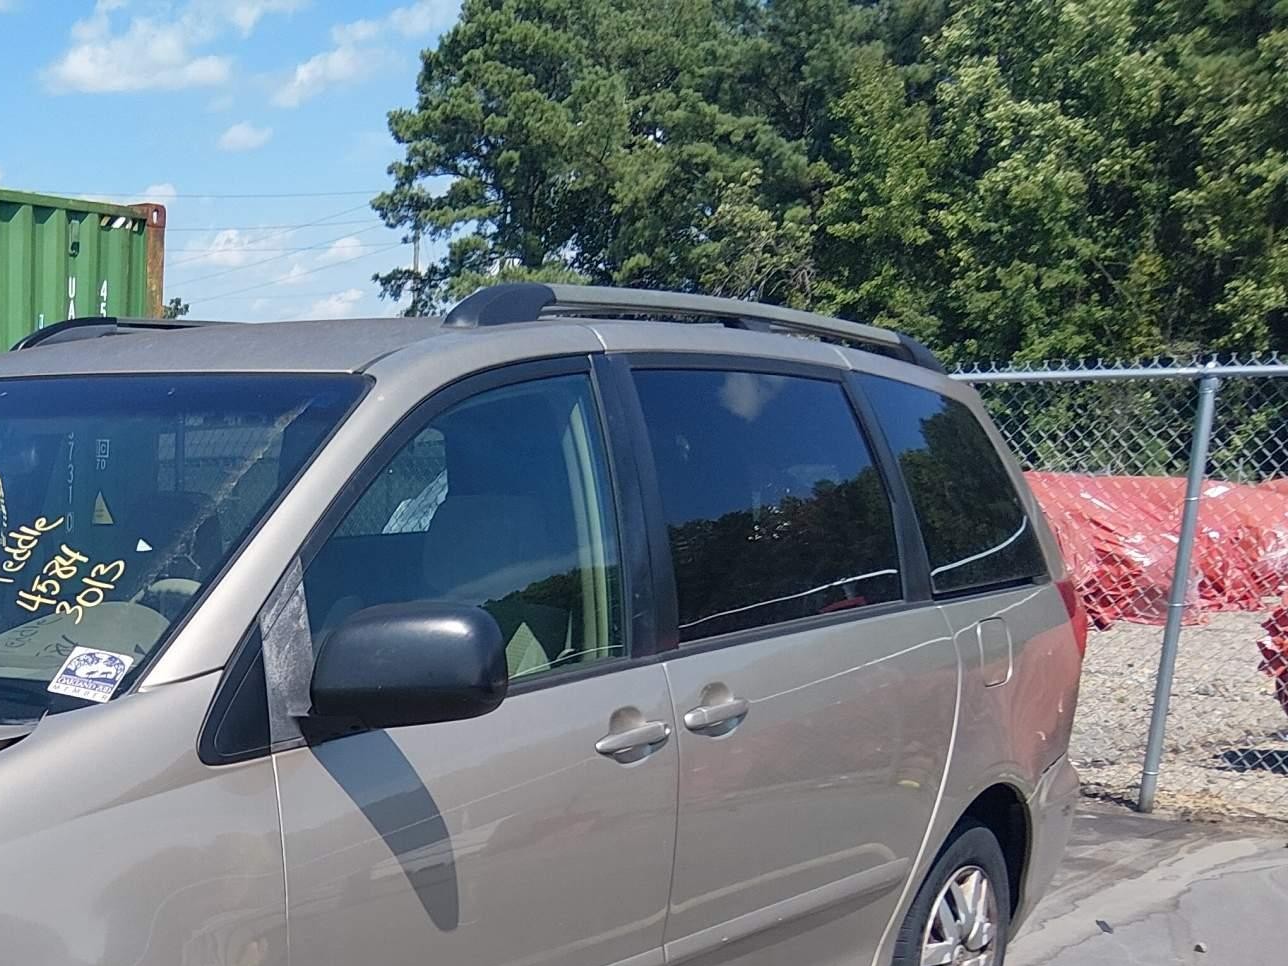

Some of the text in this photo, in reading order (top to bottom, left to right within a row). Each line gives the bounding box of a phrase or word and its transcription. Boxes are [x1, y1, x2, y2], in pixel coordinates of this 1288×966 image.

[67, 276, 76, 321] UA
[100, 280, 108, 318] 45
[15, 543, 90, 613] 4584
[55, 559, 126, 625] 3013
[57, 675, 97, 691] OAKLAND
